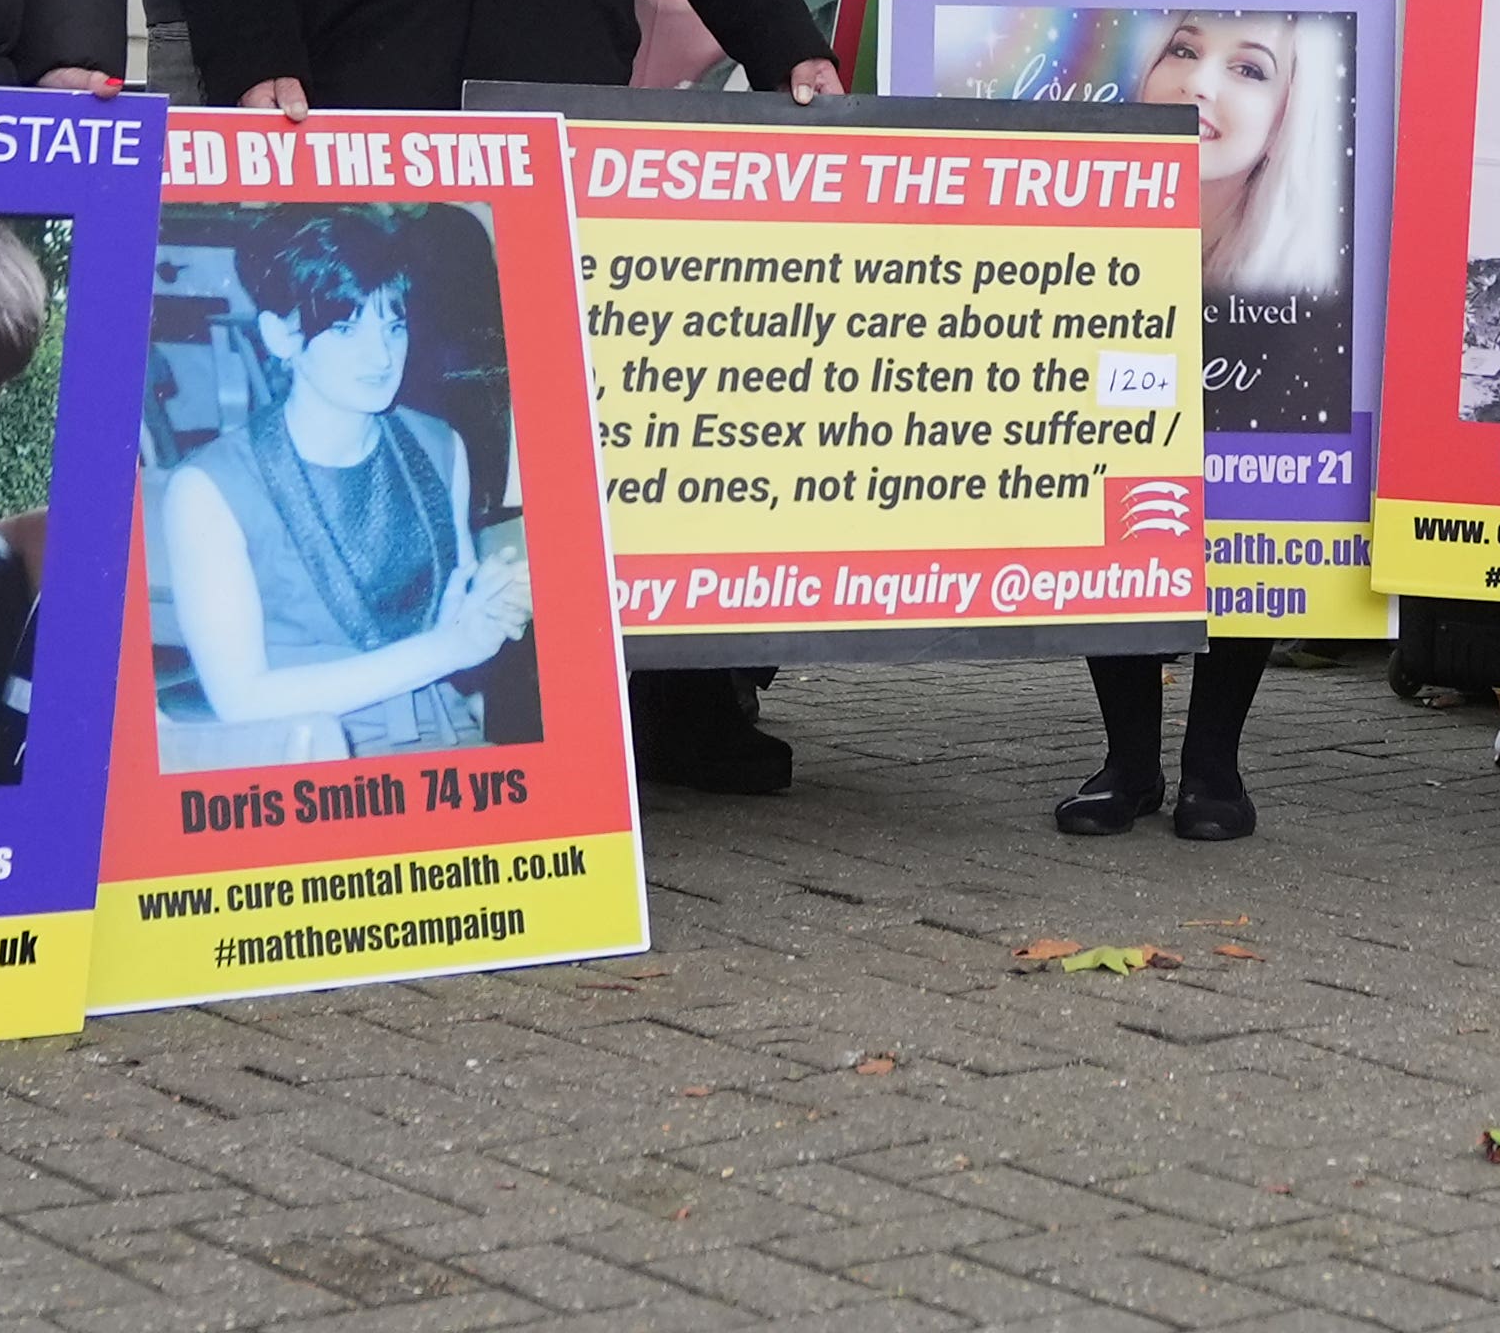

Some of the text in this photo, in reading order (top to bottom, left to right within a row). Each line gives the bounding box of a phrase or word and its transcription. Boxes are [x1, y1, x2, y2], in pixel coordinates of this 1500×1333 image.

[587, 148, 1180, 209] DESERVE THE TRUTH!
[608, 252, 843, 290] government
[854, 254, 962, 285] wants
[972, 251, 1096, 295] people
[1107, 256, 1140, 286] to
[587, 300, 1176, 345] they actually care about mental
[622, 356, 708, 399] they
[716, 357, 813, 393] need
[823, 361, 859, 393] to
[870, 357, 973, 393] listen
[986, 361, 1020, 392] to
[1032, 357, 1089, 393] the
[644, 412, 679, 448] in
[691, 413, 806, 447] Essex
[818, 411, 893, 447] who
[903, 411, 992, 446] have
[1003, 409, 1156, 445] suffered
[677, 476, 778, 510] ones,
[793, 470, 857, 502] not
[867, 466, 986, 510] ignore
[685, 565, 821, 608] Public
[834, 562, 982, 612] Inquiry
[990, 557, 1192, 611] @eputnhs
[180, 767, 528, 834] Doris Smith 74 yrs
